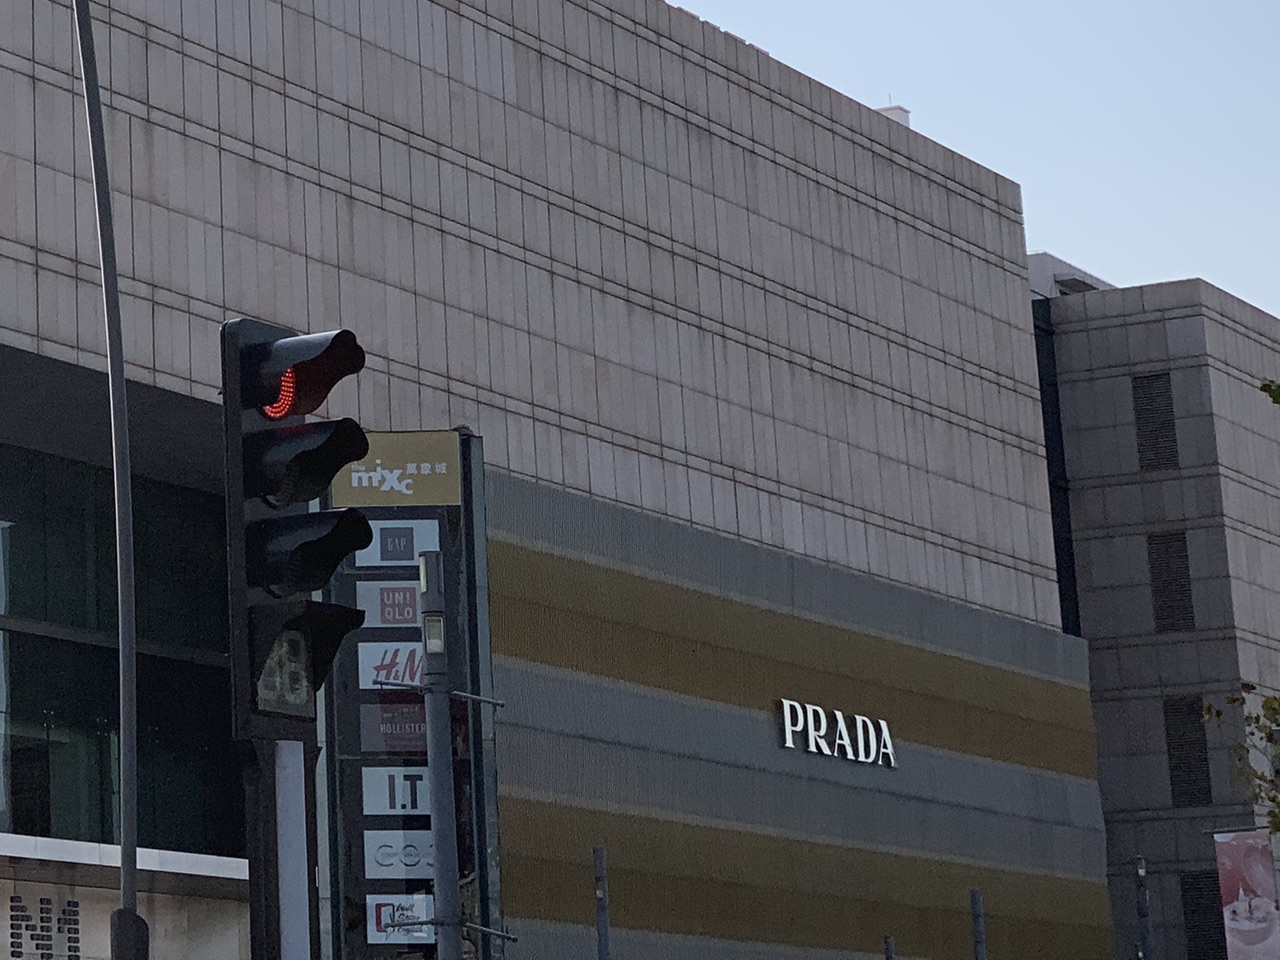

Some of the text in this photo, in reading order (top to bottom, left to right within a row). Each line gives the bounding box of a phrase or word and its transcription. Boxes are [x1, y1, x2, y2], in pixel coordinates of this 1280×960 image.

[384, 607, 413, 621] QLO
[781, 698, 898, 768] PRADA
[388, 774, 423, 809] I.T
